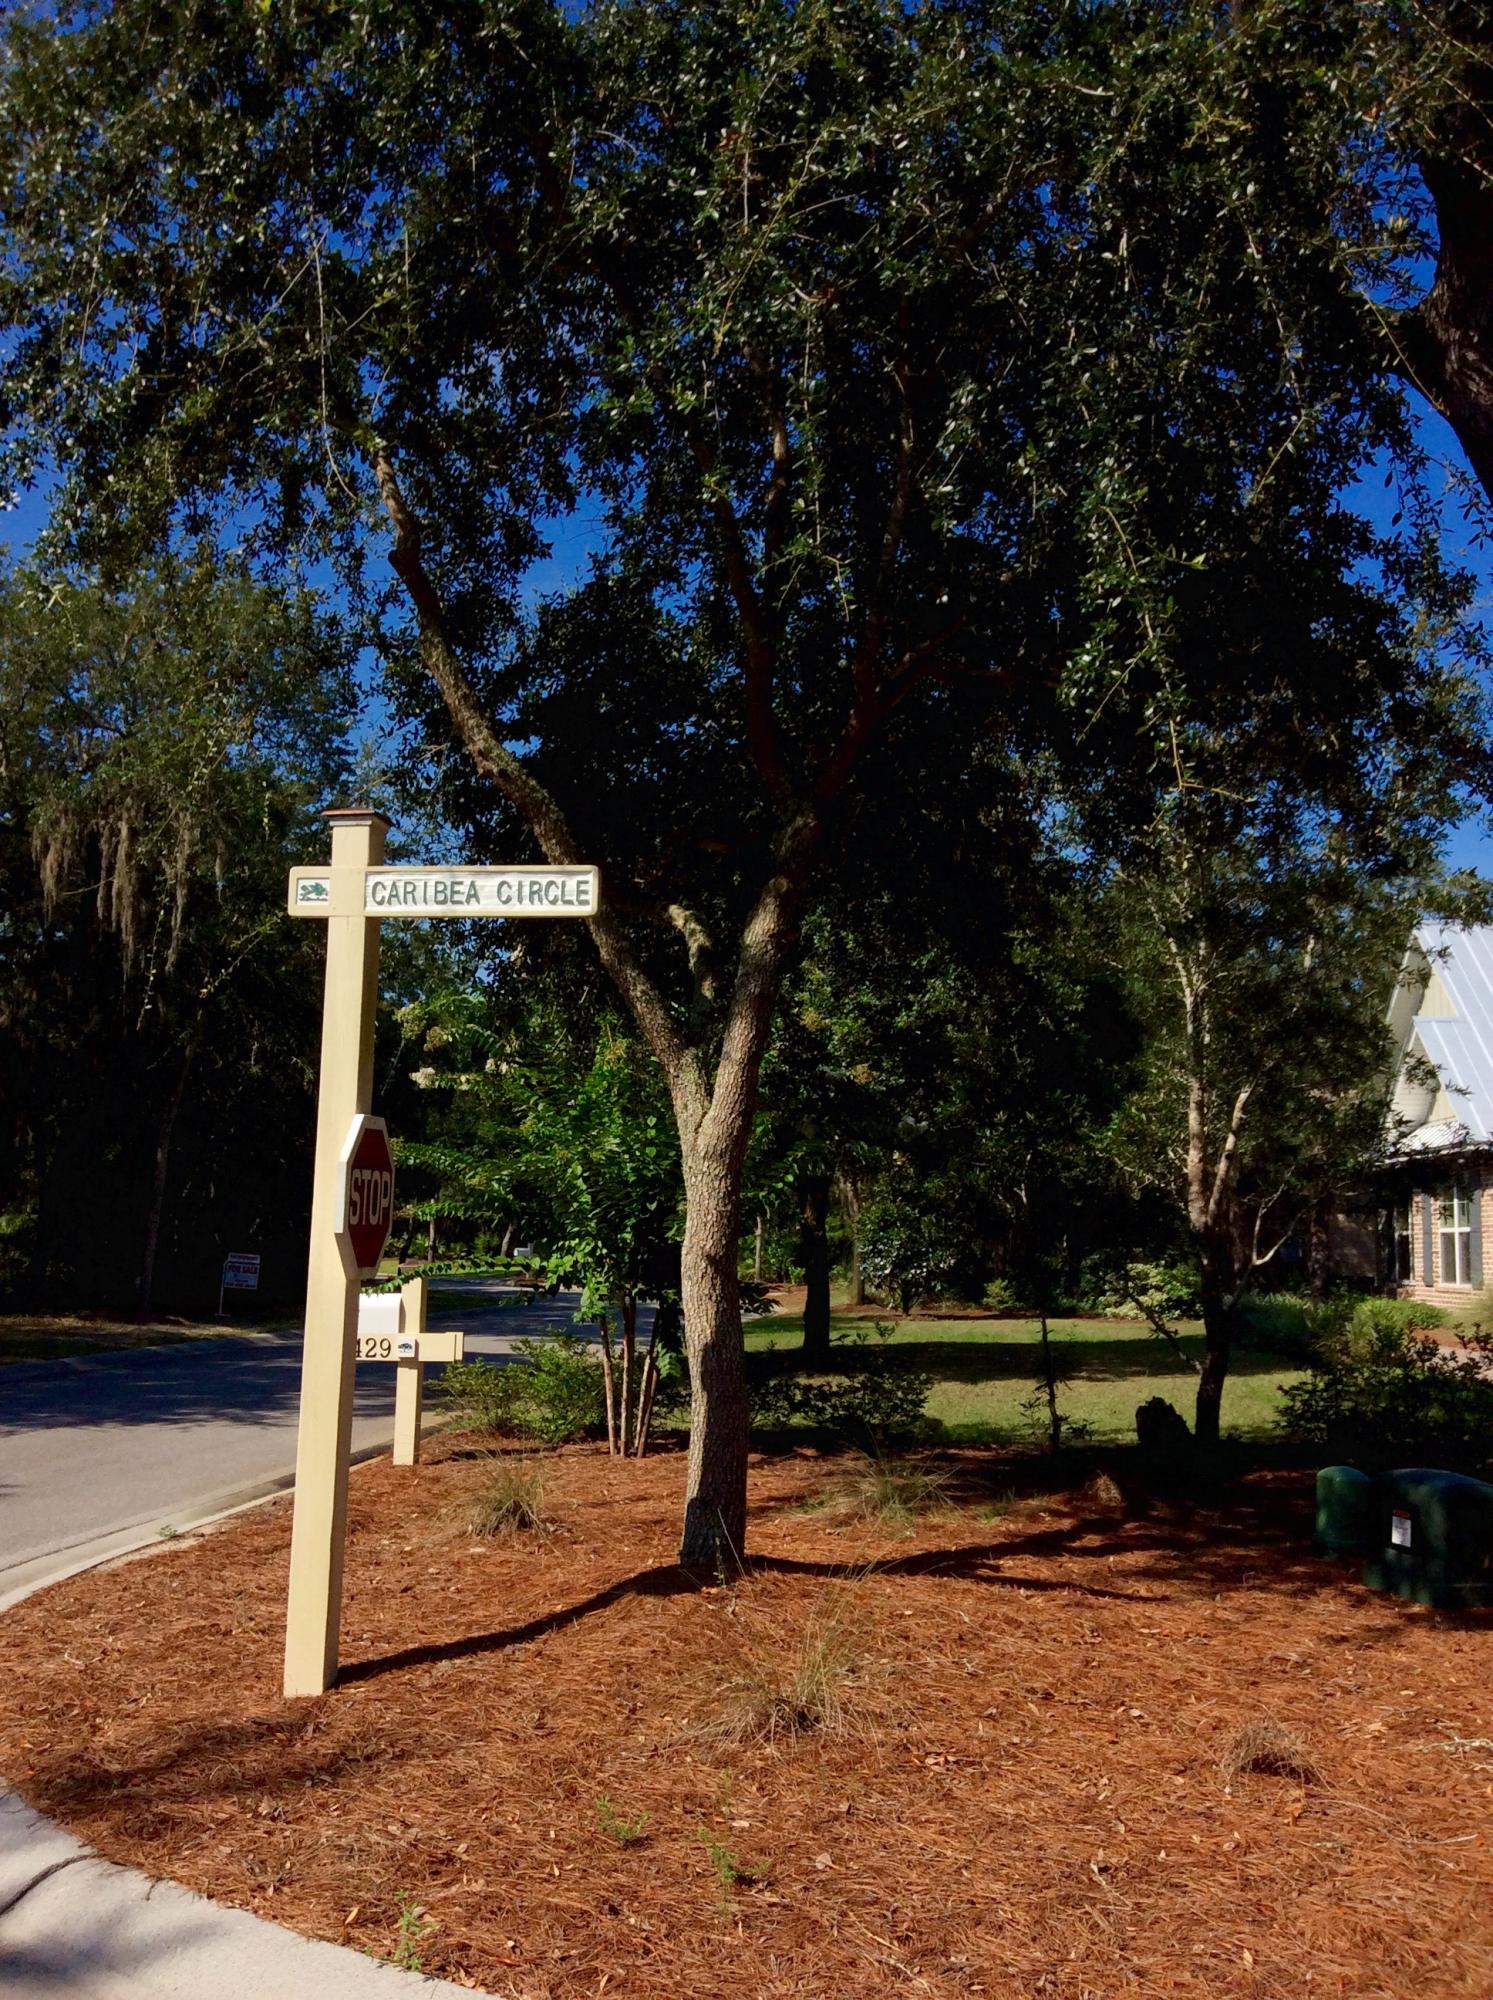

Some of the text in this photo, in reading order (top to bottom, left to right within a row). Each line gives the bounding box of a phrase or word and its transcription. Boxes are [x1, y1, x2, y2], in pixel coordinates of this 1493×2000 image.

[371, 879, 591, 906] CARIBEA CIRCLE
[349, 1168, 391, 1226] STOP
